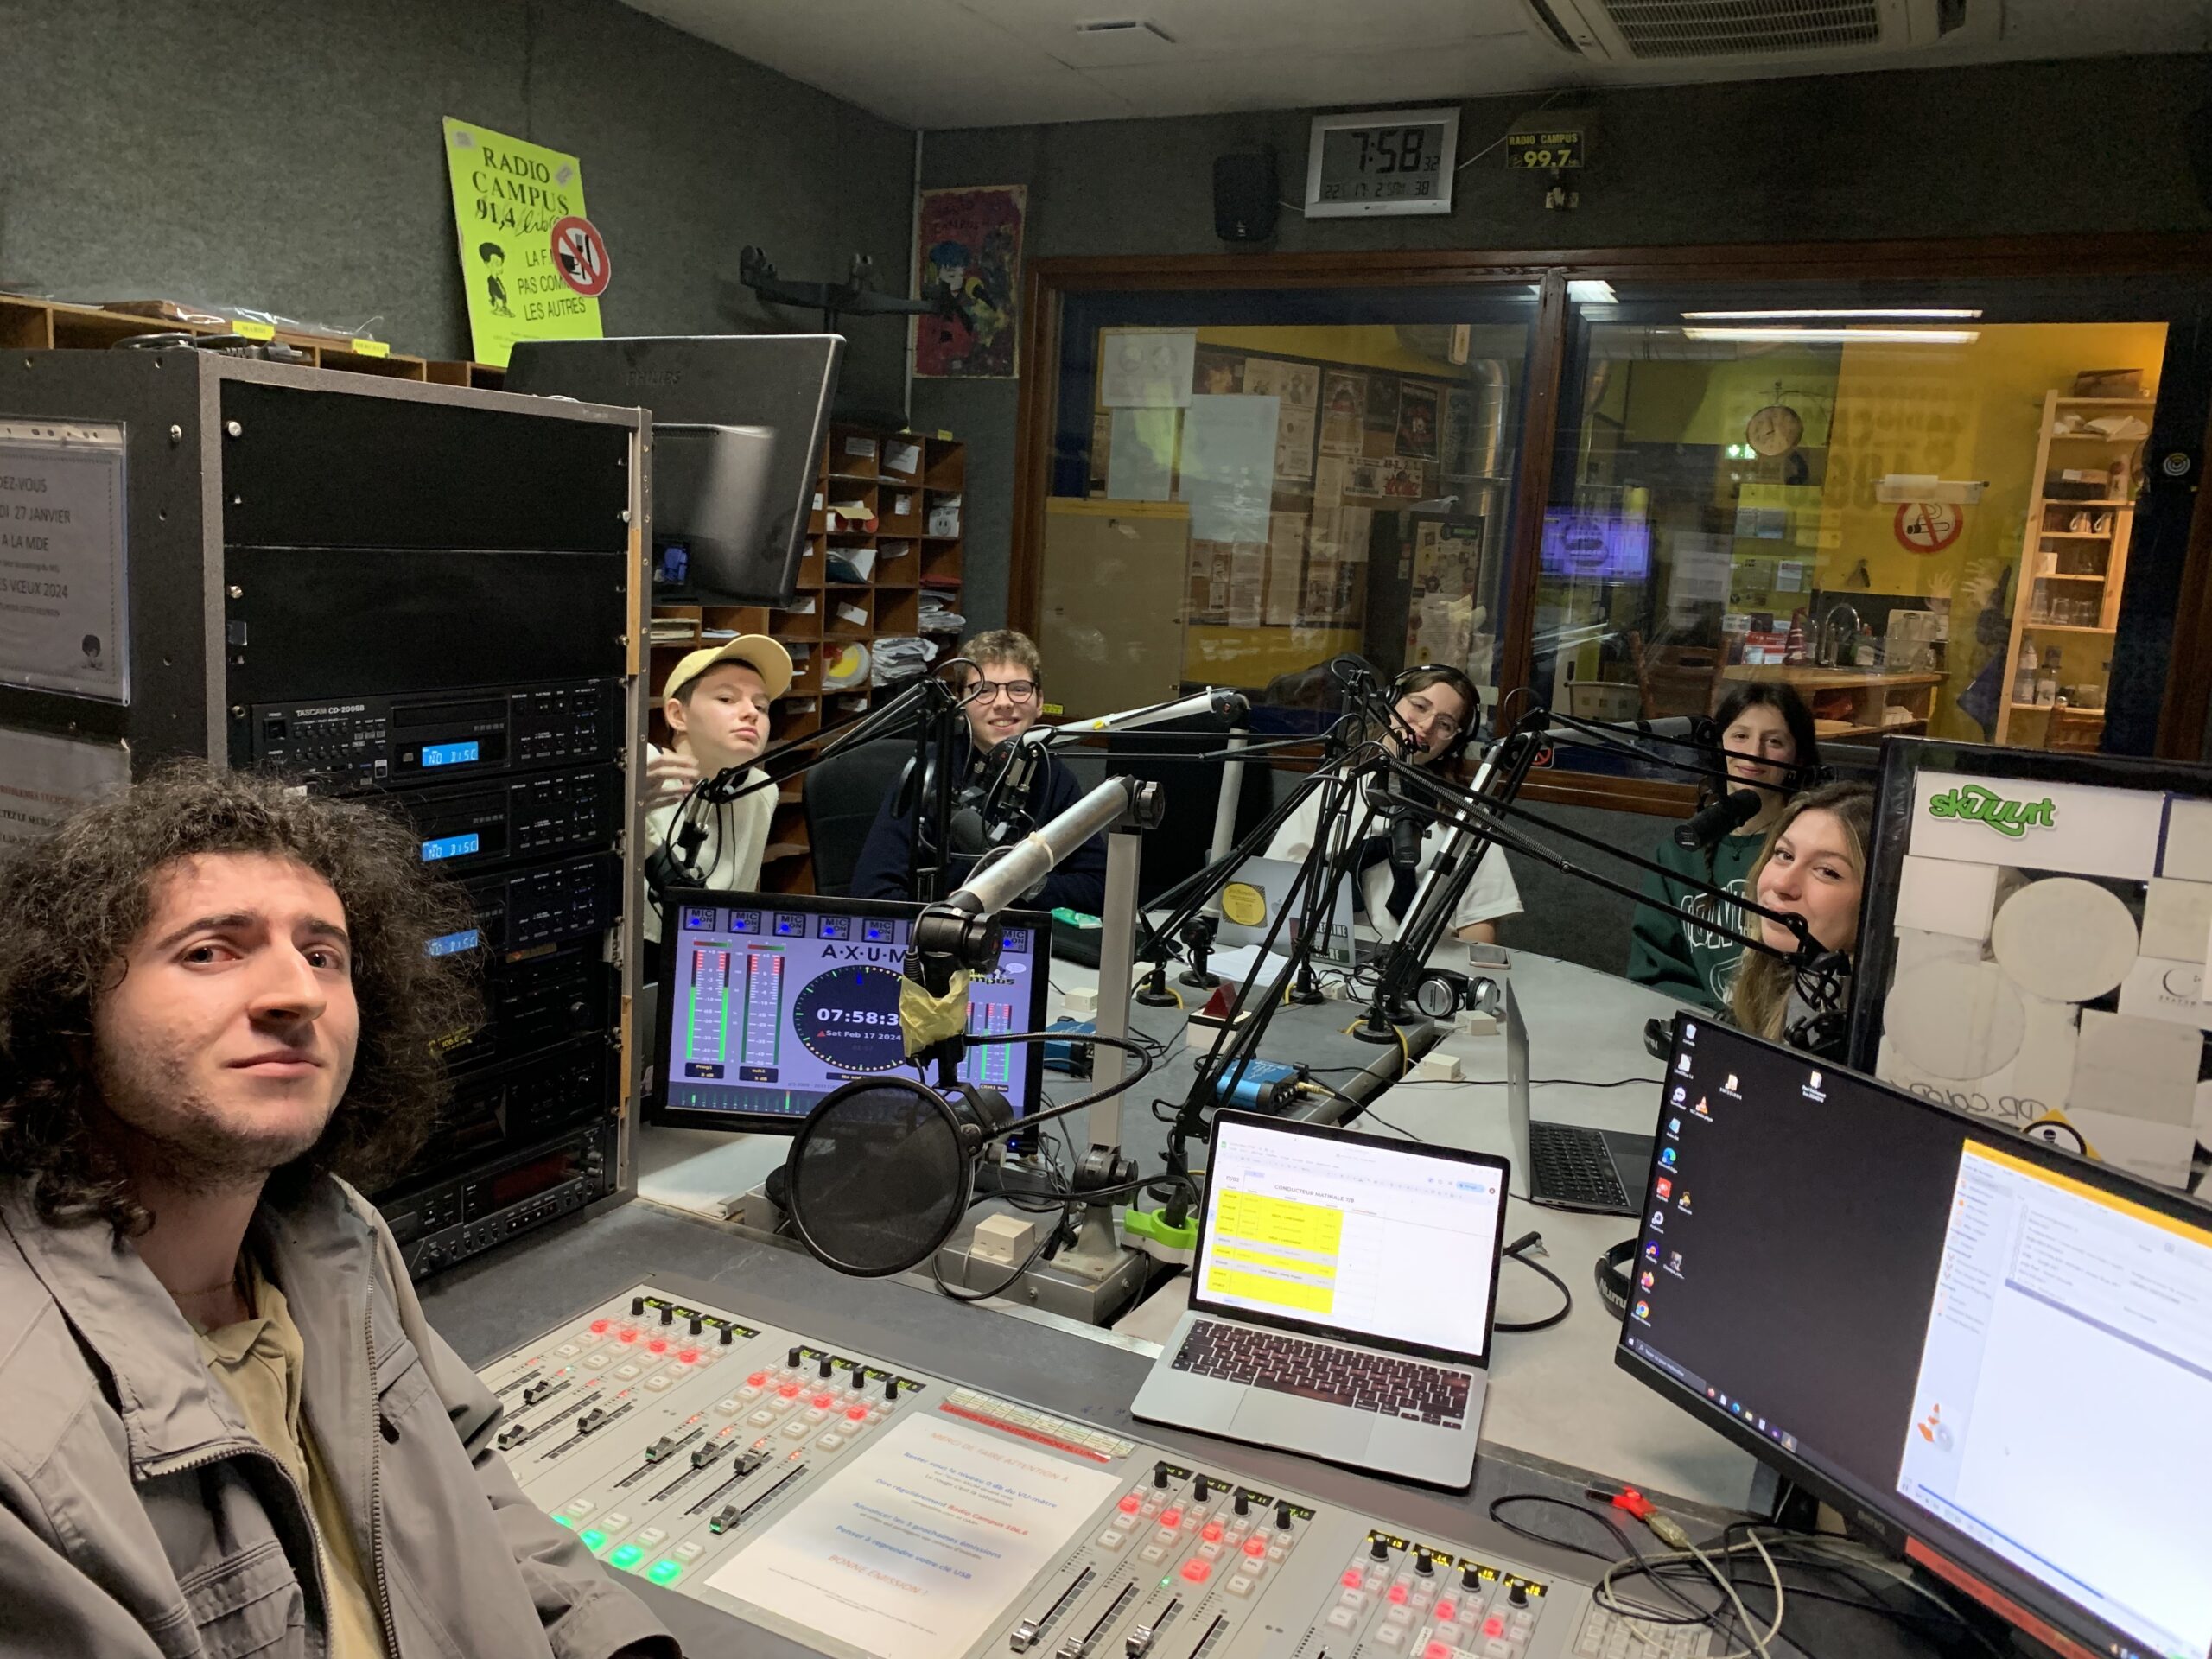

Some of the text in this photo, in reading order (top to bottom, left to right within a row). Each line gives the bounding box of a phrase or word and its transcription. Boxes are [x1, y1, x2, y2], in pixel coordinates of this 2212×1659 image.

[1509, 133, 1578, 145] RADIO CAMPUS
[1351, 129, 1440, 173] 7:58 32
[1523, 149, 1572, 168] 99.7
[482, 146, 550, 183] RADIO
[472, 171, 569, 216] CAMPUS
[476, 198, 516, 231] 91,4
[525, 250, 540, 267] LA
[518, 276, 538, 295] PAS
[524, 296, 586, 321] LES AUTRES
[14, 505, 27, 520] 27
[29, 507, 71, 524] JANVIER
[11, 534, 23, 548] LA
[25, 536, 49, 551] MDE
[43, 583, 68, 599] 2024
[296, 708, 327, 717] TASCAM
[451, 749, 477, 762] DISC
[450, 841, 477, 855] DISC
[869, 921, 891, 930] MIC
[817, 1008, 899, 1026] 07:58:3
[1274, 1185, 1314, 1197] CONDUCTEUR
[1314, 1192, 1344, 1202] MATINALE
[931, 1432, 1060, 1480] MERCI DE FAIRE ATTENTION
[904, 1452, 928, 1463] Rester
[957, 1471, 984, 1484] niveau
[875, 1478, 893, 1487] Dire
[948, 1504, 972, 1516] Radio
[972, 1514, 1004, 1528] Campus
[977, 1493, 1013, 1508] saturation
[853, 1502, 893, 1519] Annoncer
[912, 1524, 958, 1544] prochaines
[959, 1541, 1001, 1559] émissions
[836, 1525, 865, 1540] Penser
[872, 1540, 914, 1558] reprendre
[915, 1556, 938, 1567] votre
[953, 1569, 972, 1580] USB
[829, 1554, 868, 1573] BONNE
